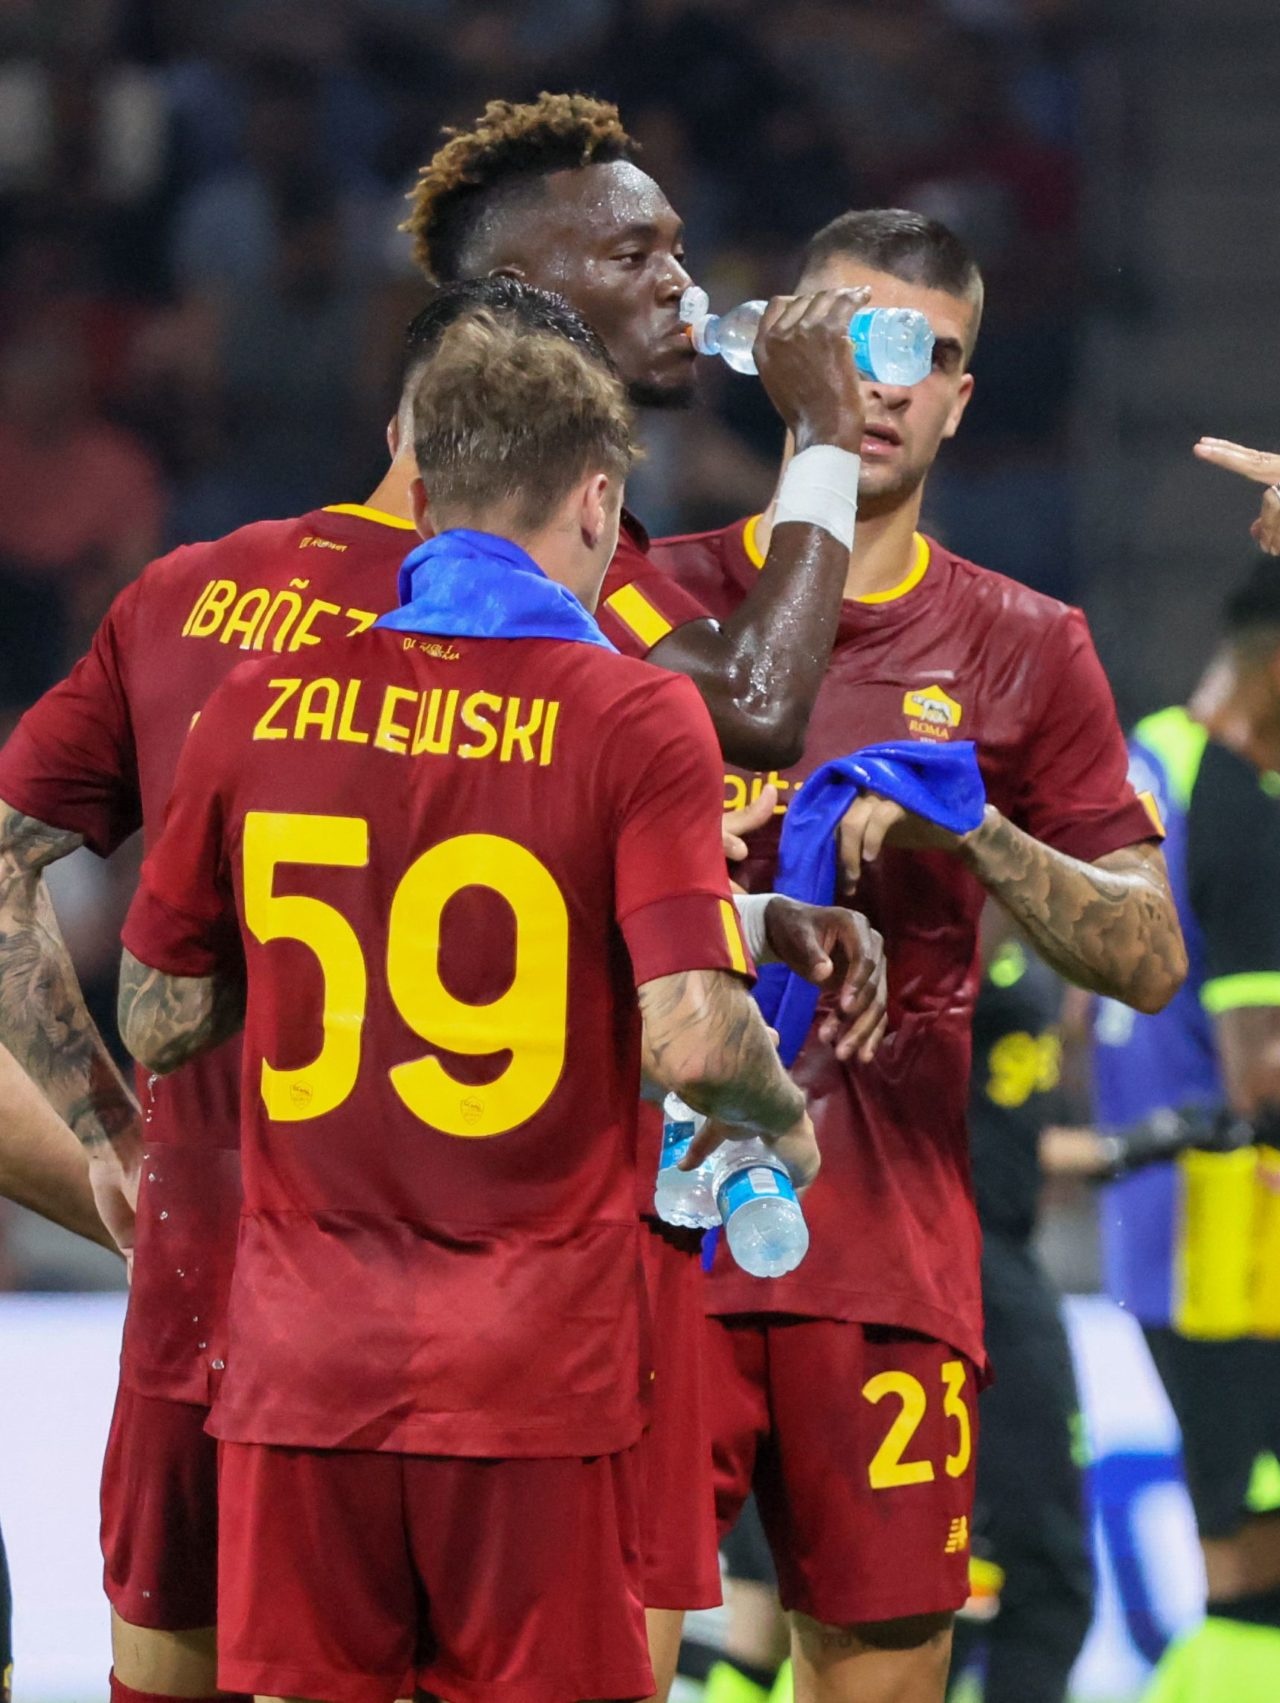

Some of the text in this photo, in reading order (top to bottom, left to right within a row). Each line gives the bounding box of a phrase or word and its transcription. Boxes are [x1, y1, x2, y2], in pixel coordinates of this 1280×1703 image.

[253, 677, 560, 766] ZALEWSKI
[241, 811, 570, 1138] 59
[861, 1360, 972, 1489] 23
